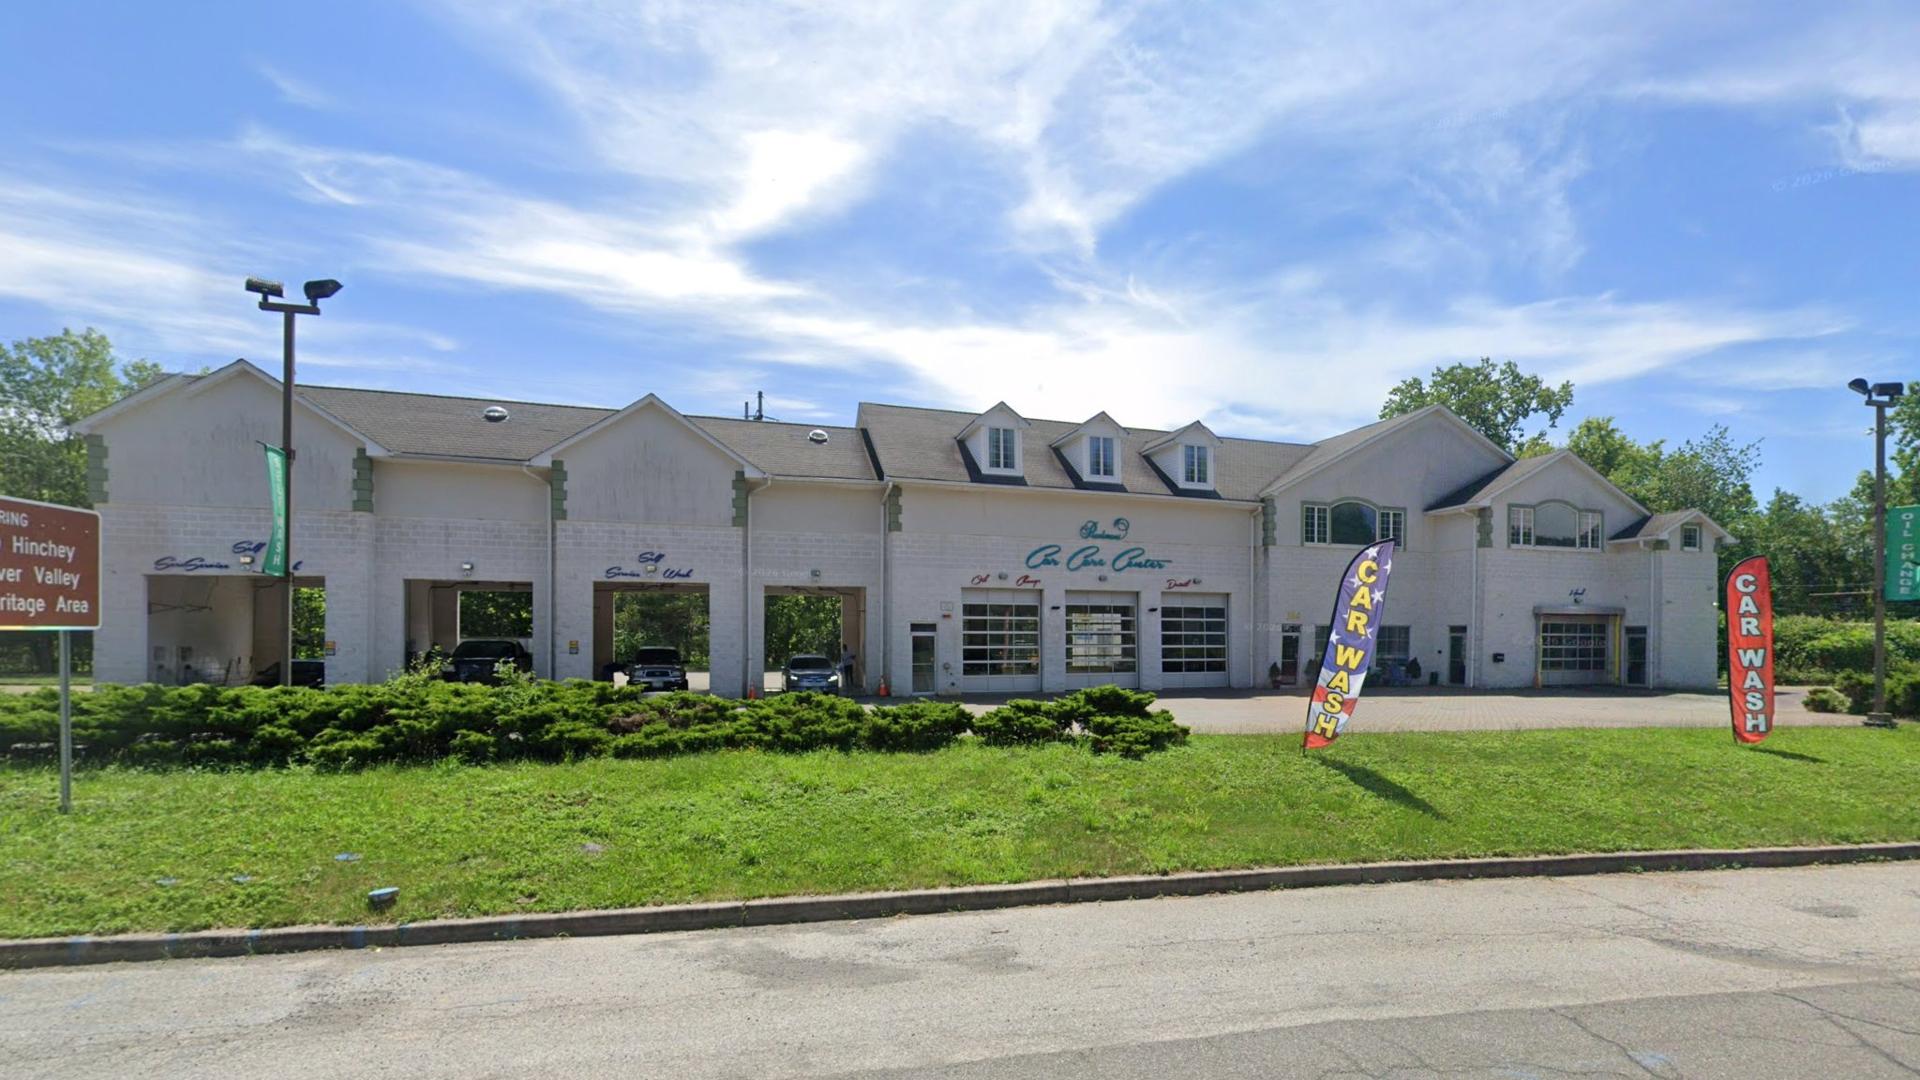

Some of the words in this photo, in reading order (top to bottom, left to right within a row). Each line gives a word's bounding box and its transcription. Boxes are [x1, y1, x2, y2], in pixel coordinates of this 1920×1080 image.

[1901, 512, 1914, 537] OIL
[12, 535, 76, 563] Hinchey
[1026, 545, 1061, 569] Car
[1066, 545, 1107, 572] Care
[1112, 547, 1174, 572] Center
[34, 566, 81, 590] Valley
[56, 595, 89, 613] Area
[1345, 560, 1379, 636] CAR
[1735, 574, 1762, 636] CAR
[1313, 643, 1365, 739] WASH
[1737, 648, 1769, 733] WASH
